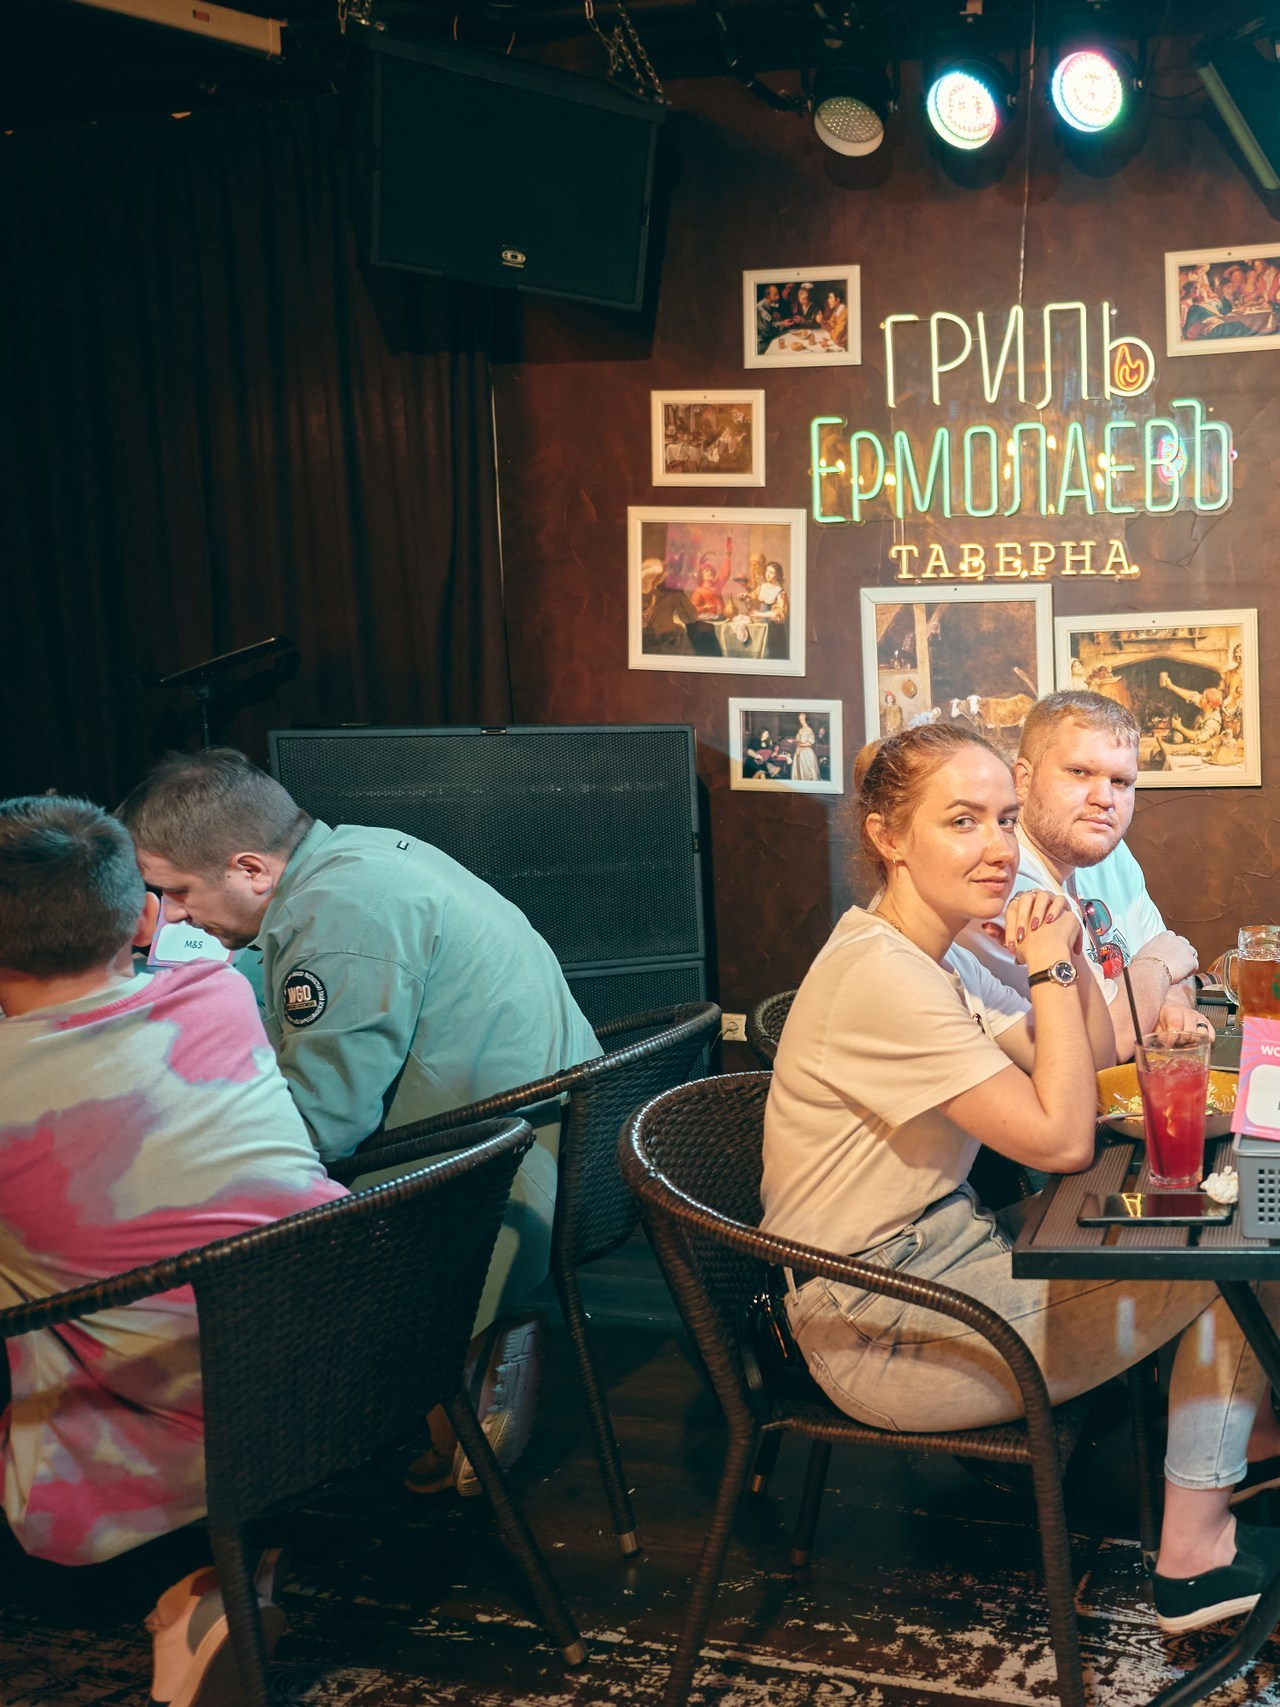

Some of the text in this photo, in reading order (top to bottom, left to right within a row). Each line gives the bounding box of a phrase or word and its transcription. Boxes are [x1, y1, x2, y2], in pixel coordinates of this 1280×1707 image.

[883, 301, 1156, 410] ГРИЛЬ
[810, 399, 1230, 523] ЕРМОЛАЕВЪ
[889, 539, 1141, 580] ТАВЕРНА
[184, 940, 204, 950] M&S
